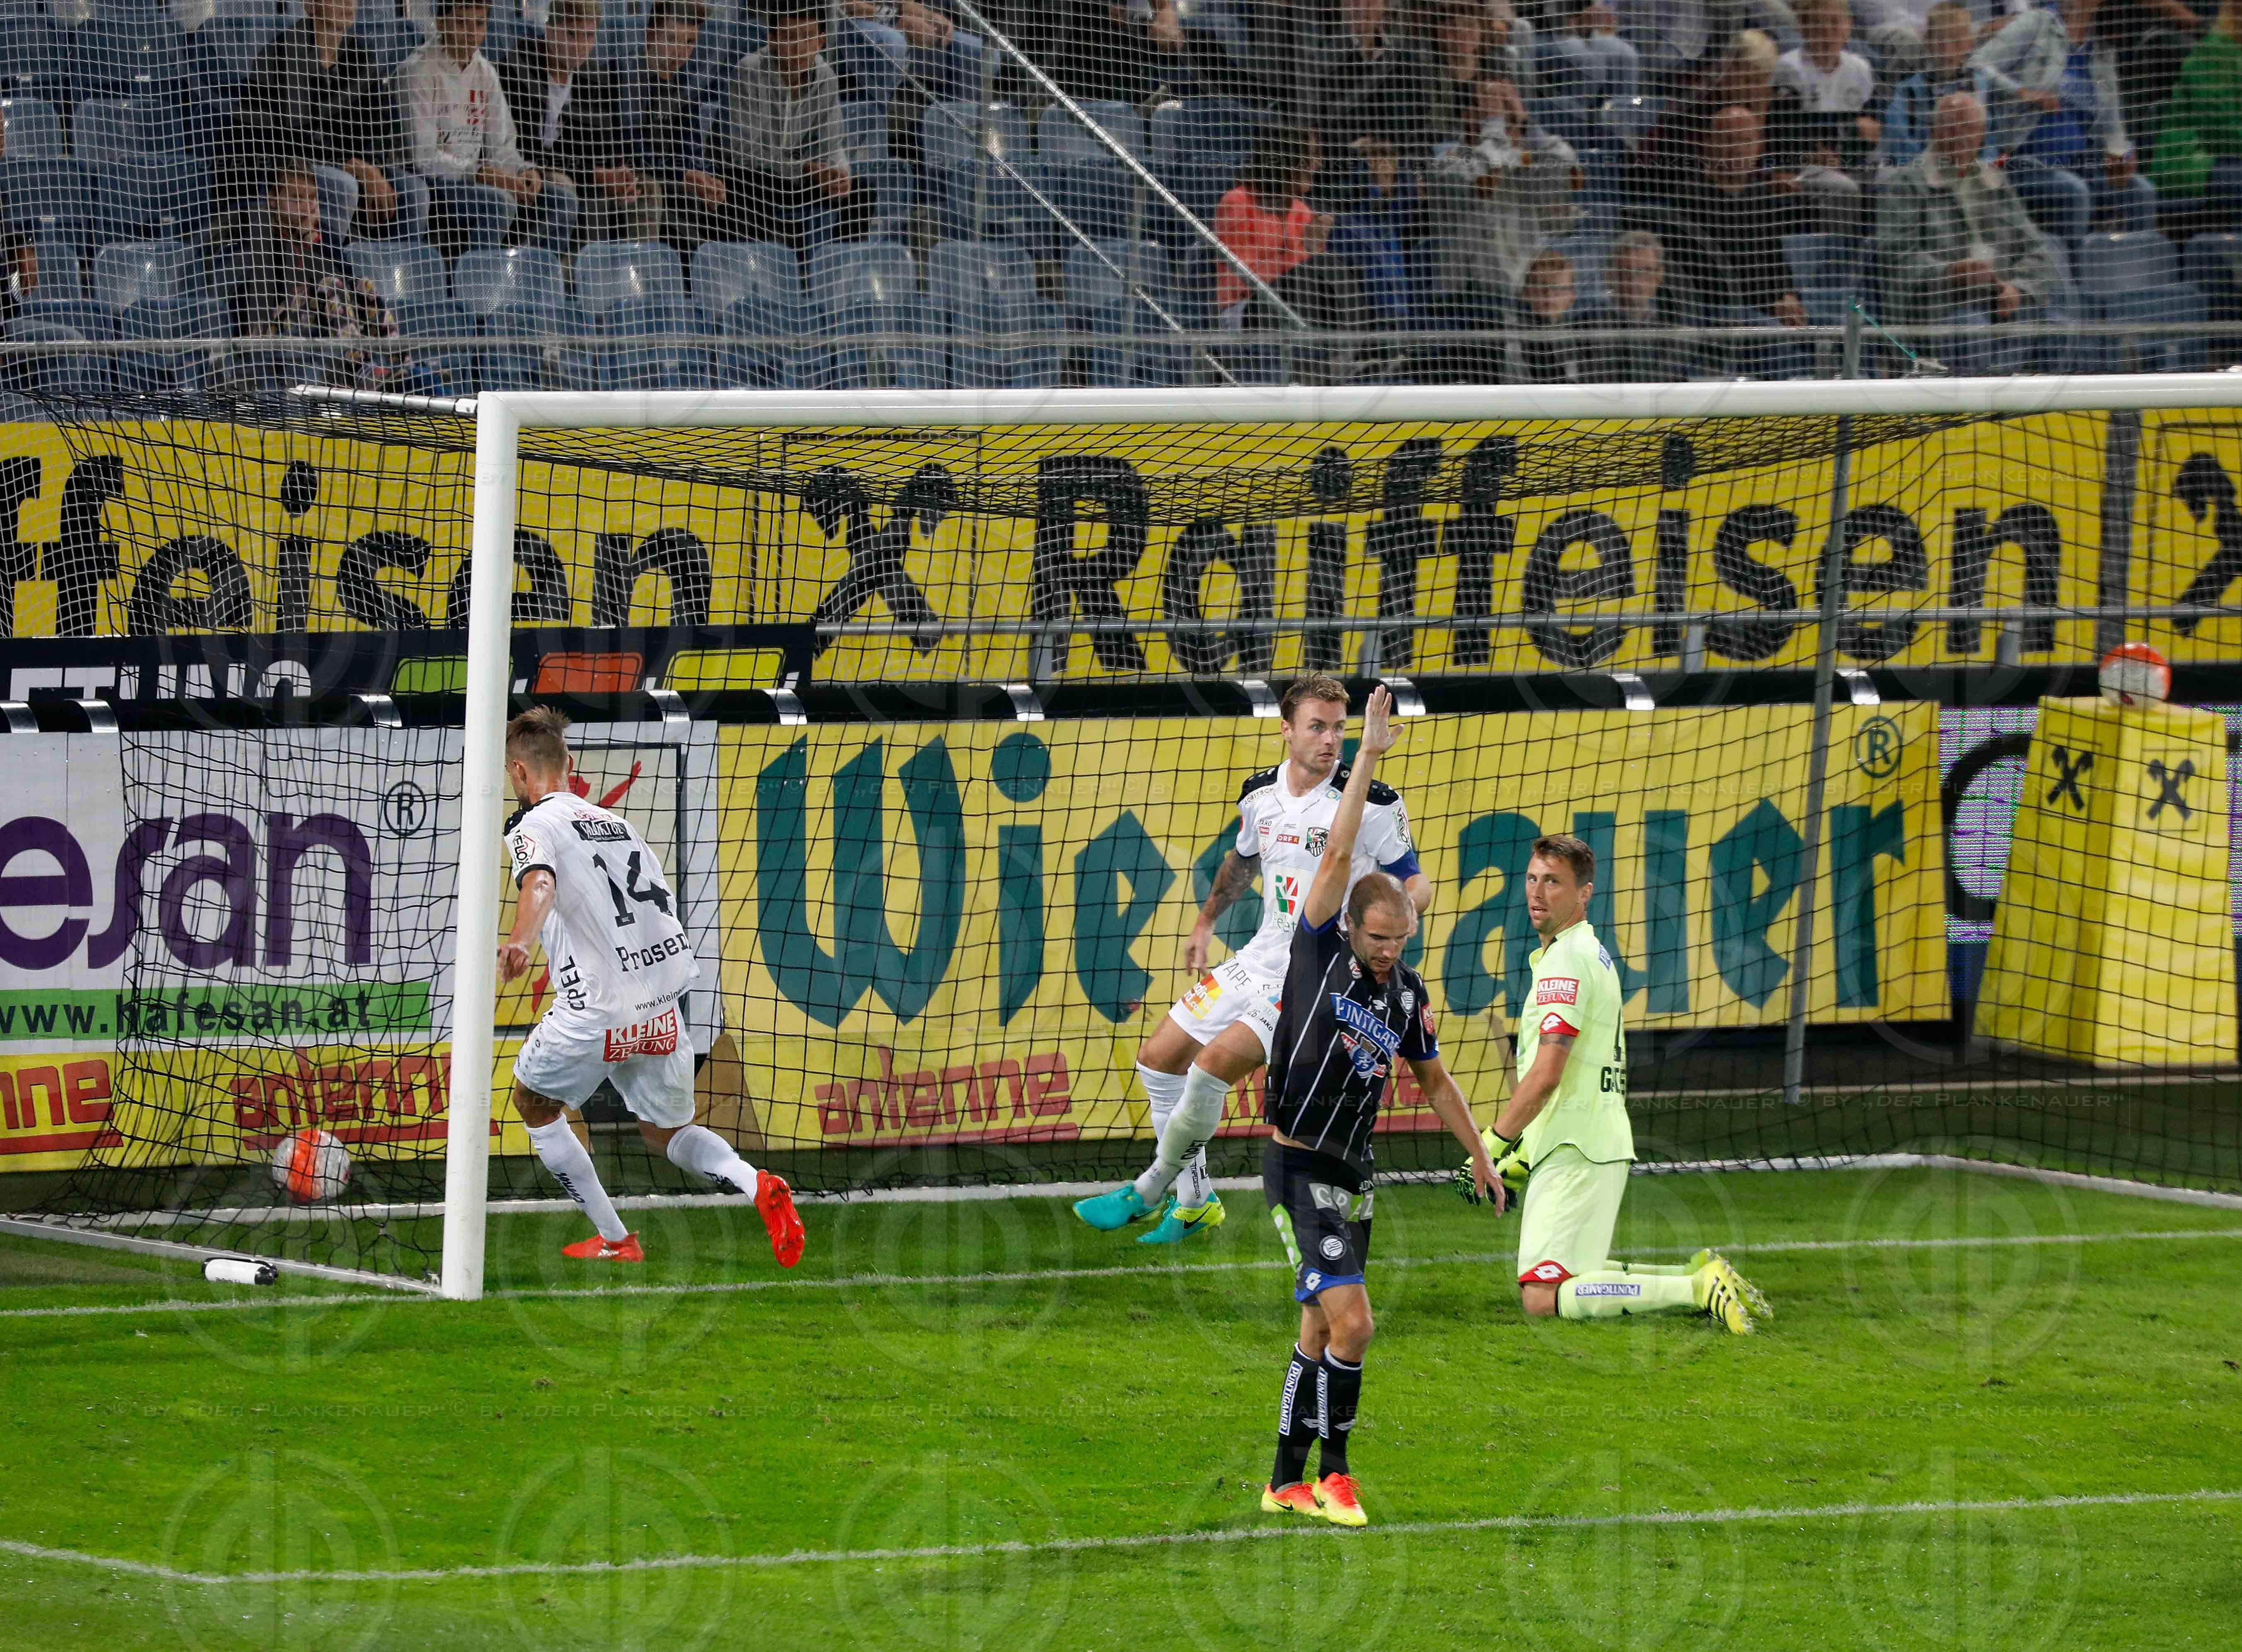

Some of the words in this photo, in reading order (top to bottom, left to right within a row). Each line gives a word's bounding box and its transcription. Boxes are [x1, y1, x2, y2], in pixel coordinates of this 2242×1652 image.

[1032, 434, 2061, 674] Raiffeisen
[1309, 840, 1327, 848] WAC
[592, 851, 674, 927] 14
[1537, 993, 1575, 1003] ZEITUNG
[1538, 979, 1576, 993] KLEINE
[611, 1012, 676, 1044] KLEINE
[1259, 1017, 1273, 1031] JAKO
[609, 1036, 675, 1059] ZETUNG
[230, 1046, 451, 1129] antenn
[814, 1043, 1072, 1135] antenne
[1280, 1365, 1300, 1432] PUNTIGAMER
